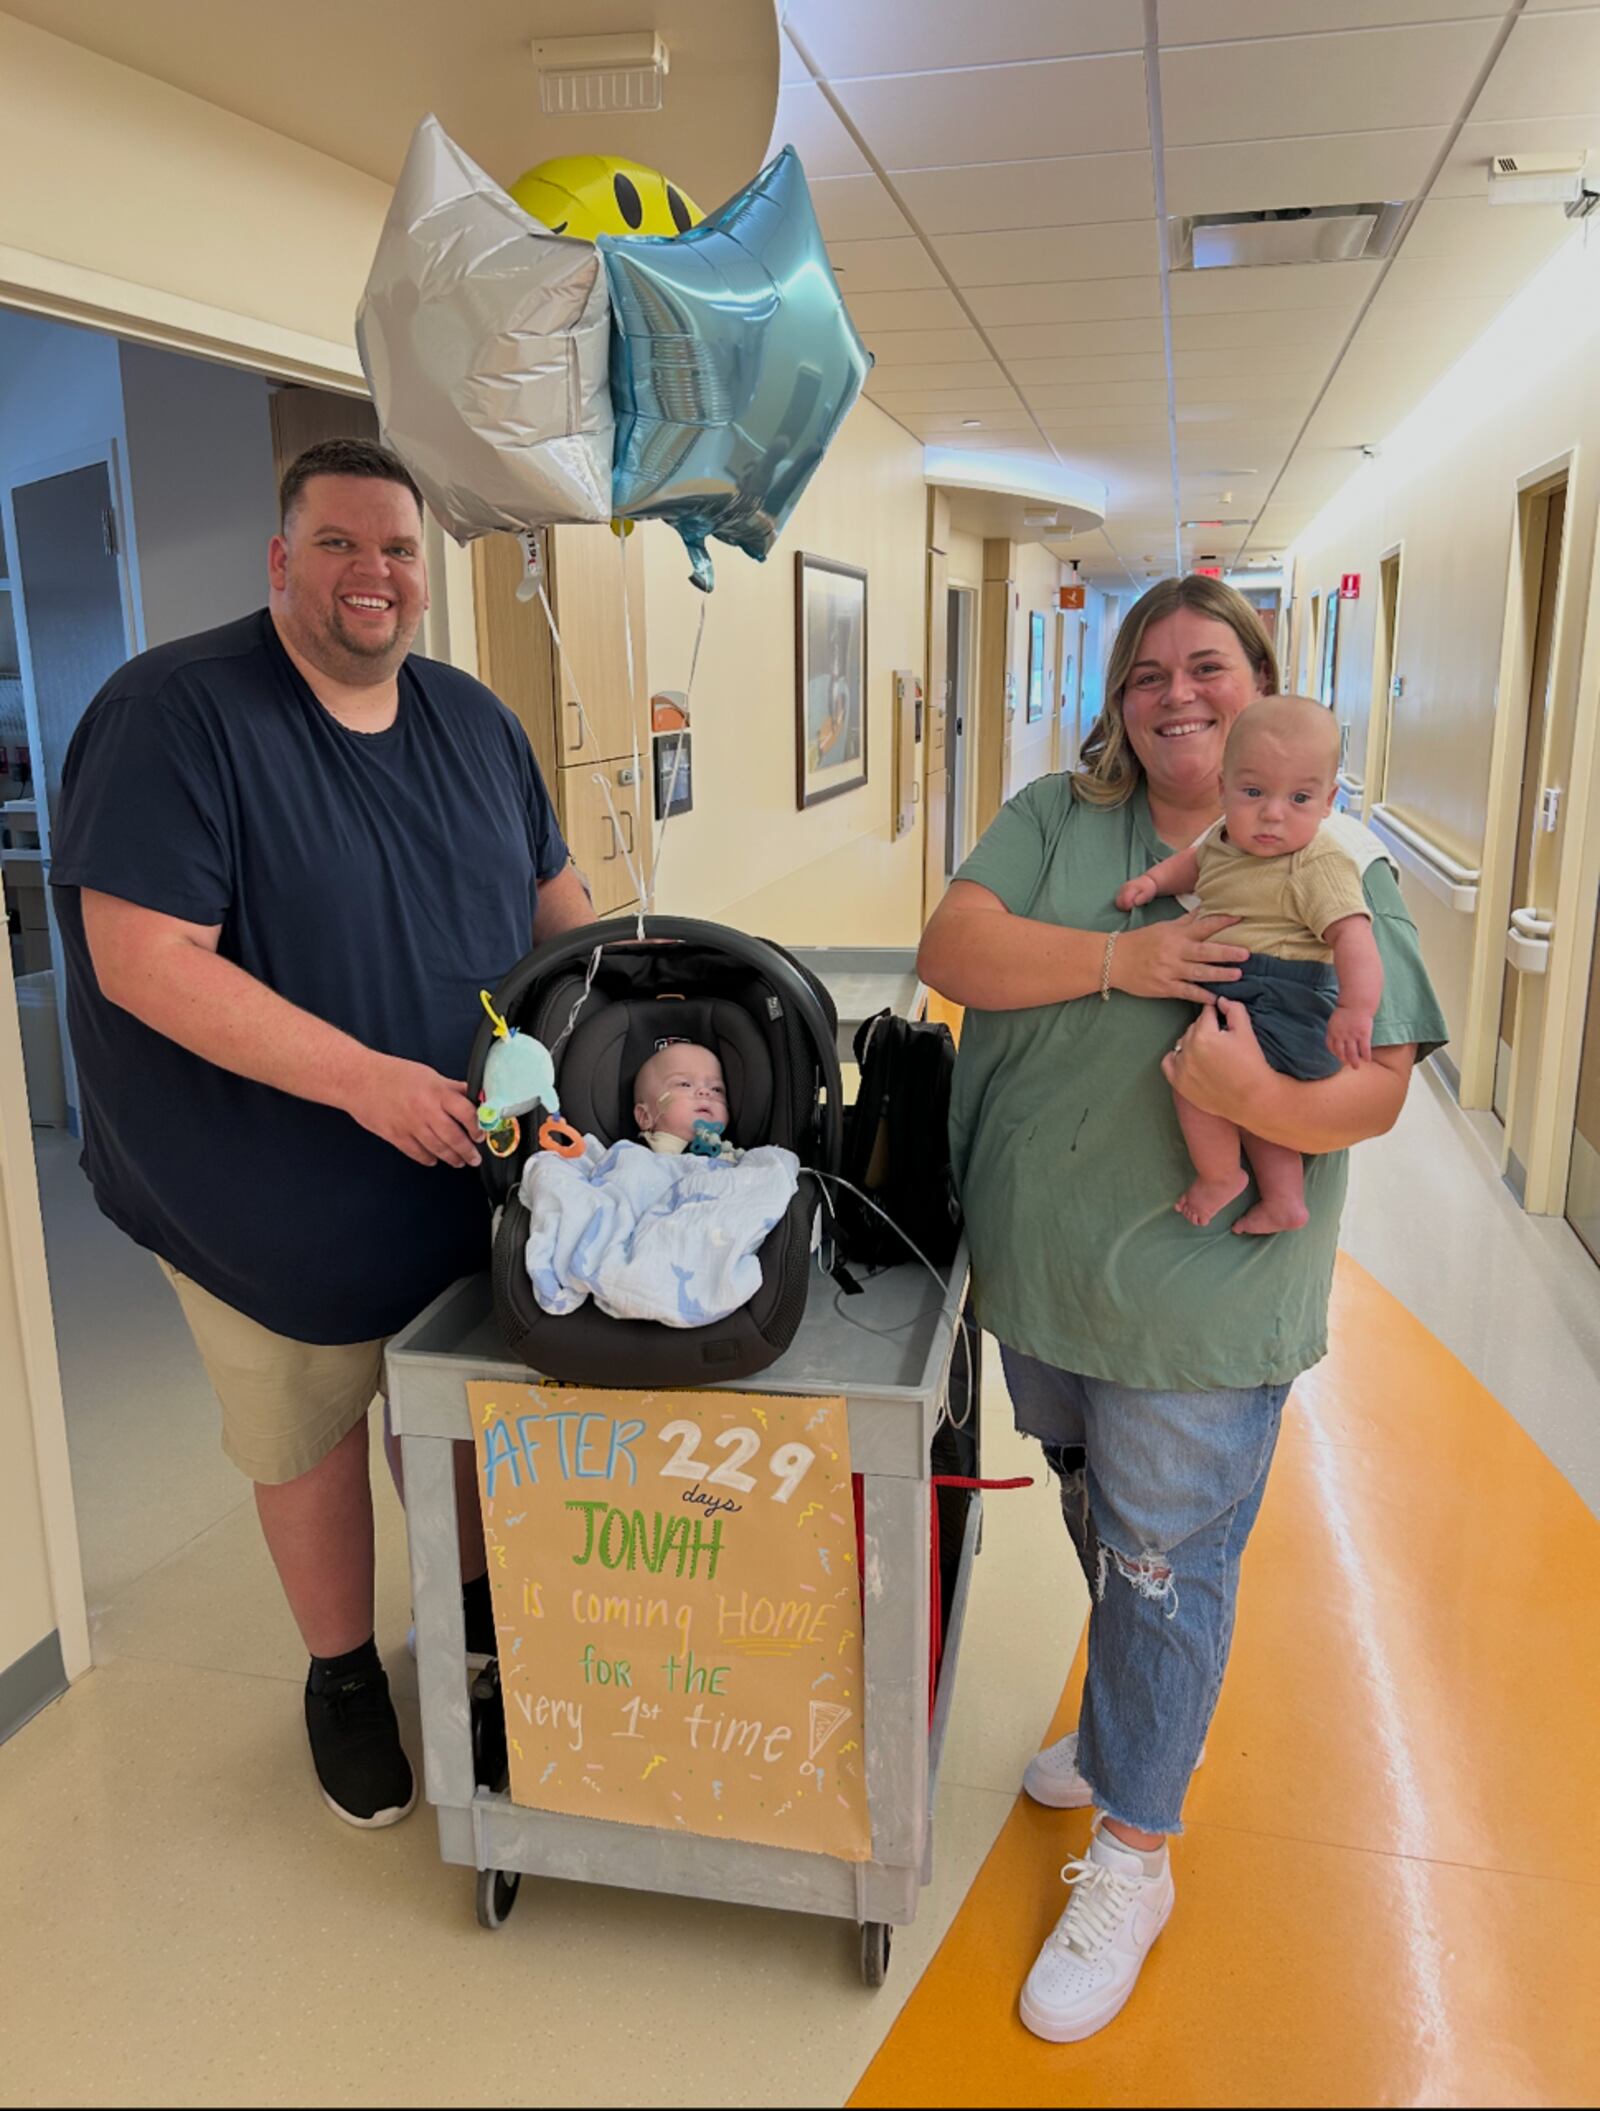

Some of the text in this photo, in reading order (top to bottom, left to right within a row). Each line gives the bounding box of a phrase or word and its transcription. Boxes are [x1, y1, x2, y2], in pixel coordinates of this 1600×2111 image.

[484, 1411, 817, 1504] AFTER 229
[564, 1500, 726, 1580] JONAH
[681, 1484, 743, 1518] days
[522, 1578, 838, 1661] is coming HOME
[513, 1690, 584, 1752] very
